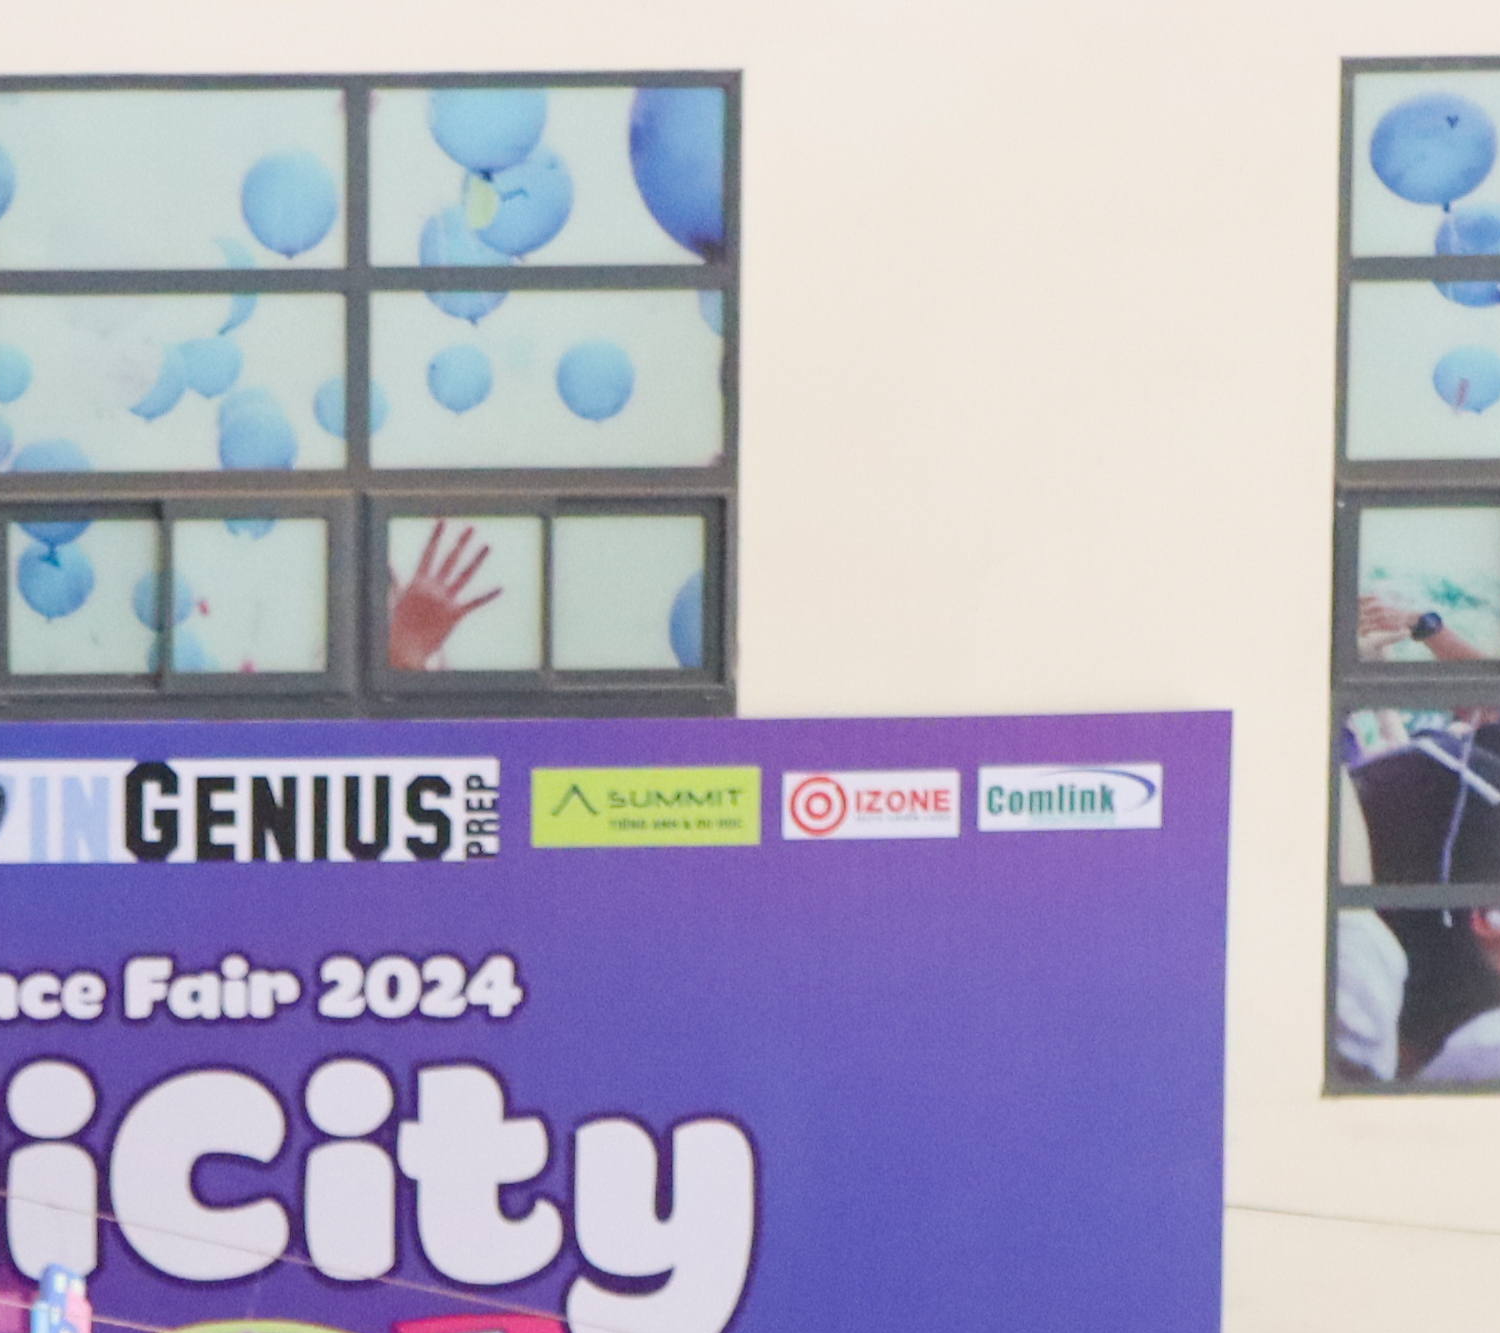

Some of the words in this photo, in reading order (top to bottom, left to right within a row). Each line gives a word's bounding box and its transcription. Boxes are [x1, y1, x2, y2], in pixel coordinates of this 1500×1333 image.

[607, 789, 743, 808] SUMMIT
[854, 788, 951, 813] IZONE
[987, 784, 1115, 815] Comlink
[465, 773, 499, 860] PREP
[124, 956, 300, 1019] Fair
[318, 956, 523, 1018] 2024
